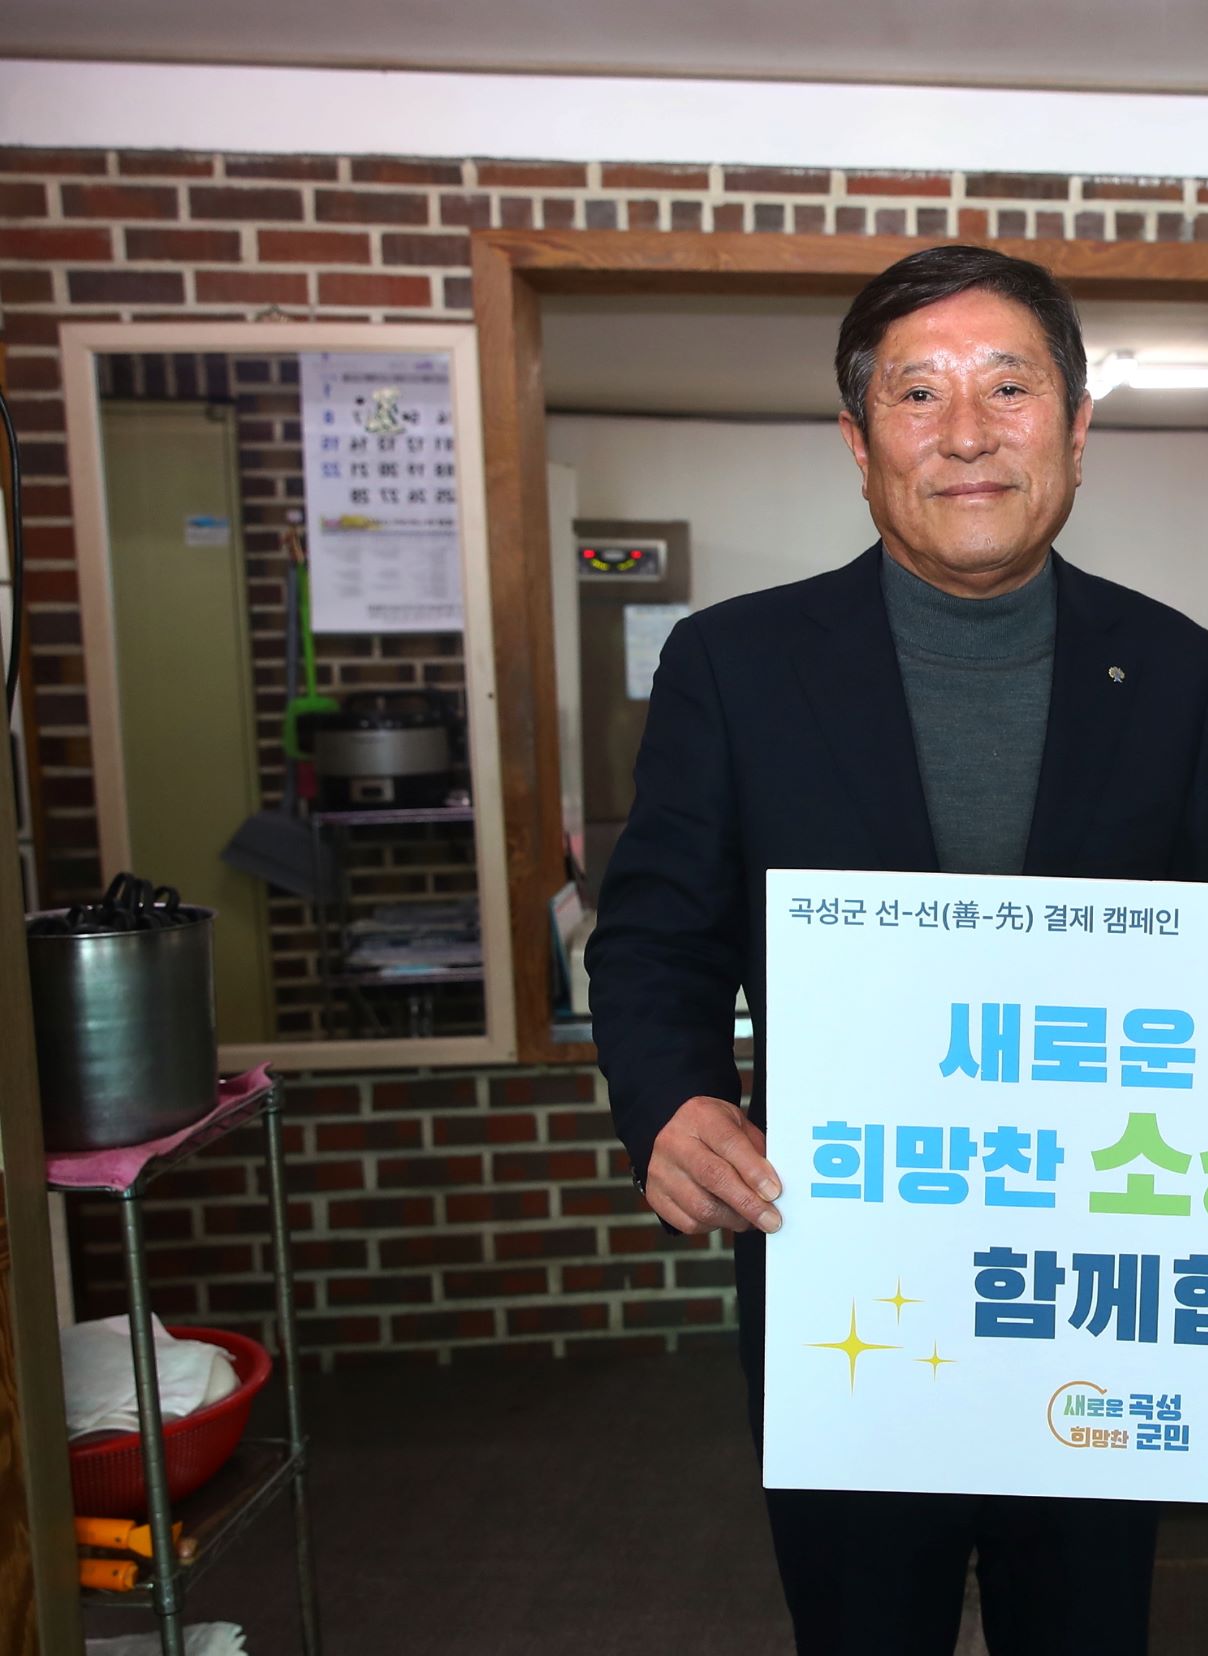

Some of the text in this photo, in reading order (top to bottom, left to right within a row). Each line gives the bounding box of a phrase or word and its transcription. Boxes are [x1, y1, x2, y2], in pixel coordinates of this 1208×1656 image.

[789, 898, 1180, 935] 곡성군 선-선(善-先) 결제 캠페인
[938, 1002, 1196, 1089] 새로운
[810, 1120, 1065, 1209] 희망찬
[1063, 1393, 1182, 1421] 새로운 곡성
[1070, 1423, 1189, 1451] 희망찬 군민
